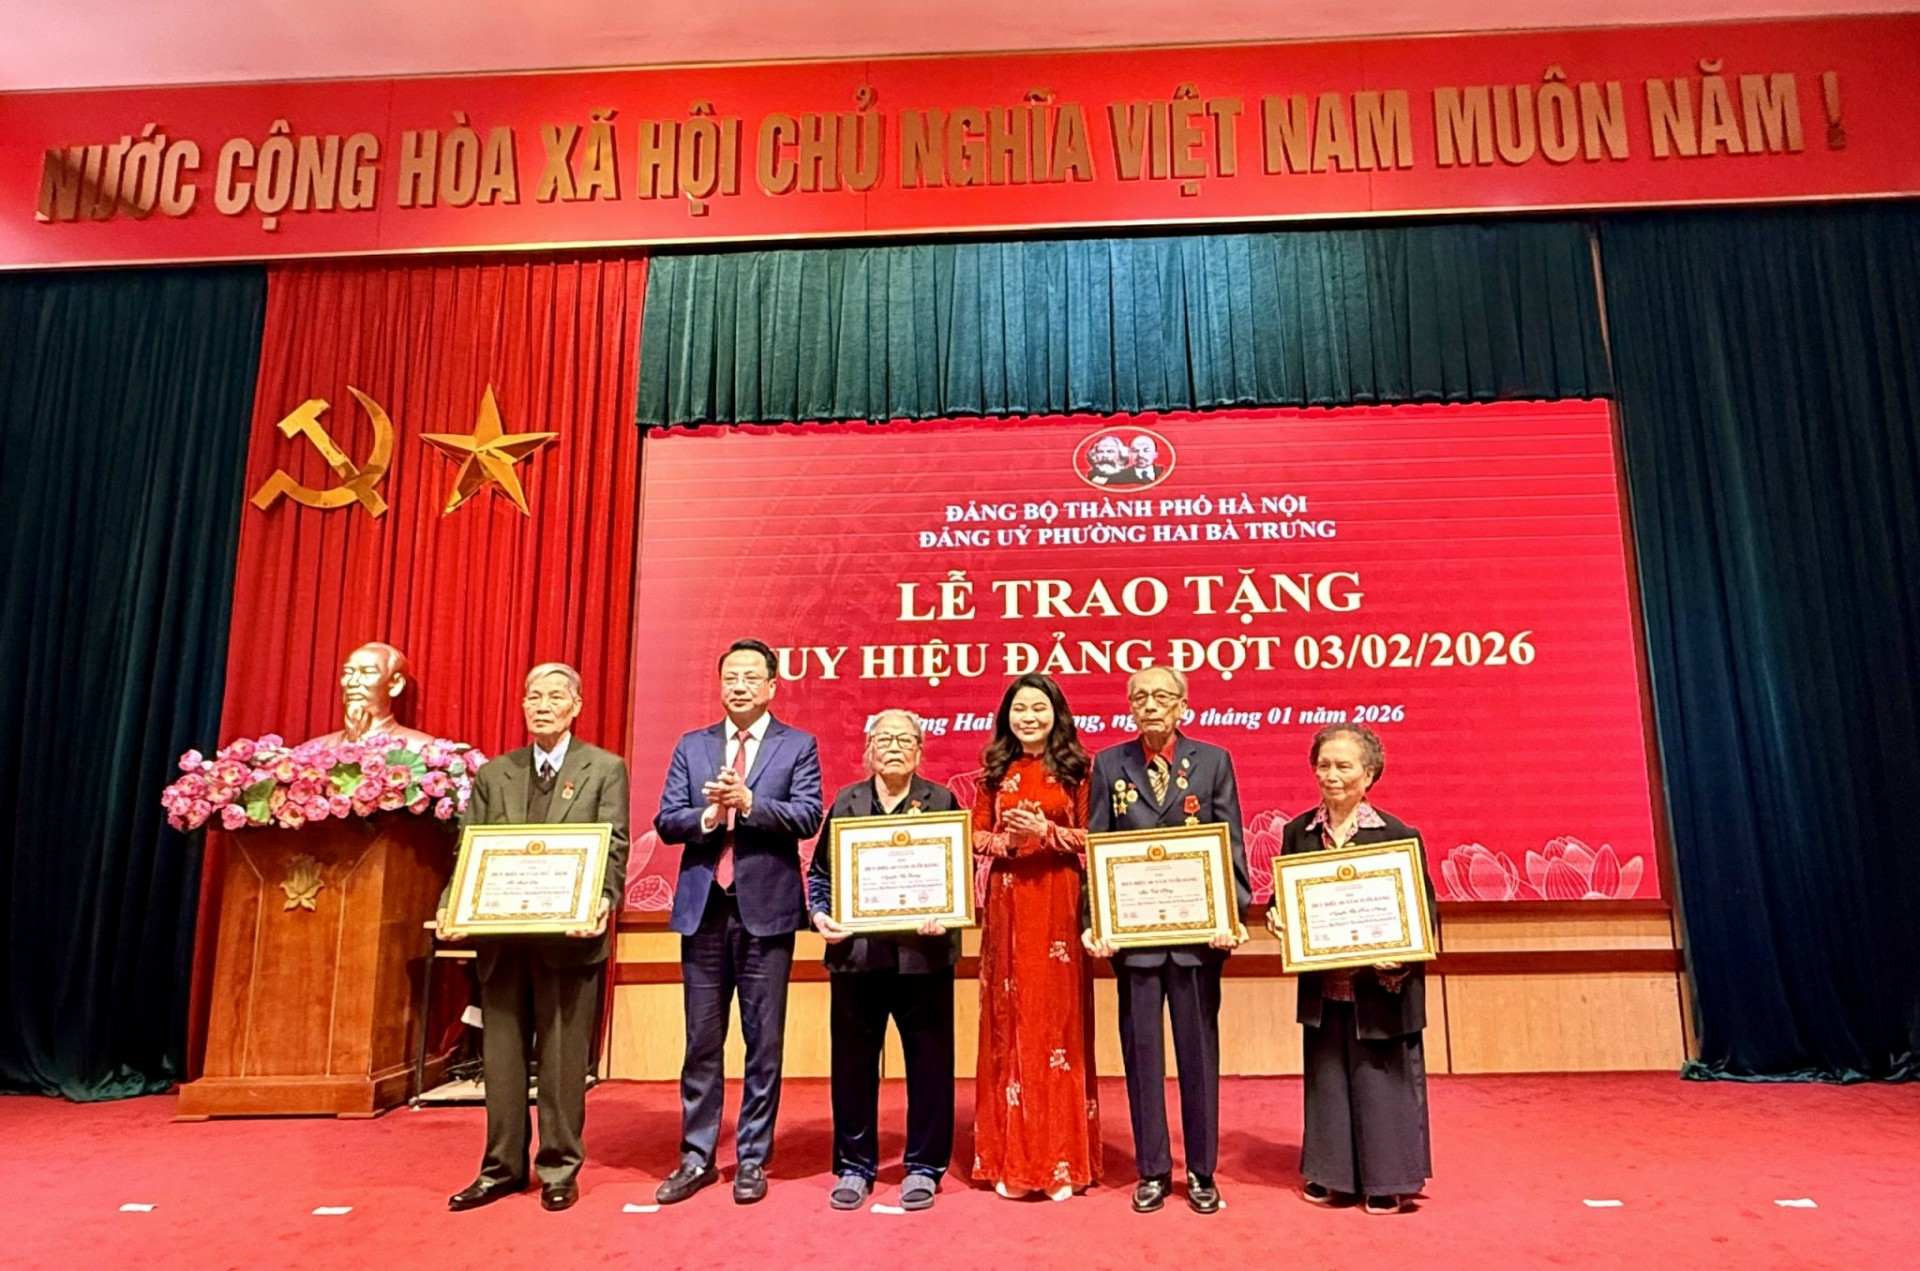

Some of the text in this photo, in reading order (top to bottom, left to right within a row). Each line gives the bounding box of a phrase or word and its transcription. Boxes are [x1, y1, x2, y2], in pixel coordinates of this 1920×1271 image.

[35, 123, 199, 222] NƯỚC
[214, 119, 379, 231] CỘNG
[399, 111, 517, 207] HÒA
[537, 107, 620, 202] XÃ
[638, 101, 742, 216] HỘI
[757, 85, 883, 197] CHỦ
[902, 87, 1093, 189] NGHĨA
[1107, 83, 1242, 197] VIỆT
[1262, 90, 1414, 175] NAM
[1433, 66, 1629, 167] MUÔN
[1645, 58, 1804, 160] NĂM
[946, 501, 1017, 522] ĐẢNG
[1023, 501, 1058, 524] BỘ
[1063, 497, 1153, 518] THÀNH
[1218, 492, 1255, 515] HÀ
[1261, 494, 1308, 518] NỘI
[919, 526, 991, 548] ĐẢNG
[1038, 522, 1146, 546] PHƯỜNG
[1152, 524, 1199, 542] HAI
[1206, 518, 1240, 541] BÀ
[1245, 519, 1336, 540] TRƯNG
[896, 568, 1365, 625] LỄ TRAO TẶNG
[773, 631, 1536, 687] UY HIỆU ĐẢNG ĐỢT 03/02/2026
[953, 711, 994, 731] Hai
[1200, 707, 1262, 730] tháng
[1267, 706, 1293, 725] 01
[1299, 706, 1347, 725] năm
[1352, 704, 1405, 723] 2026
